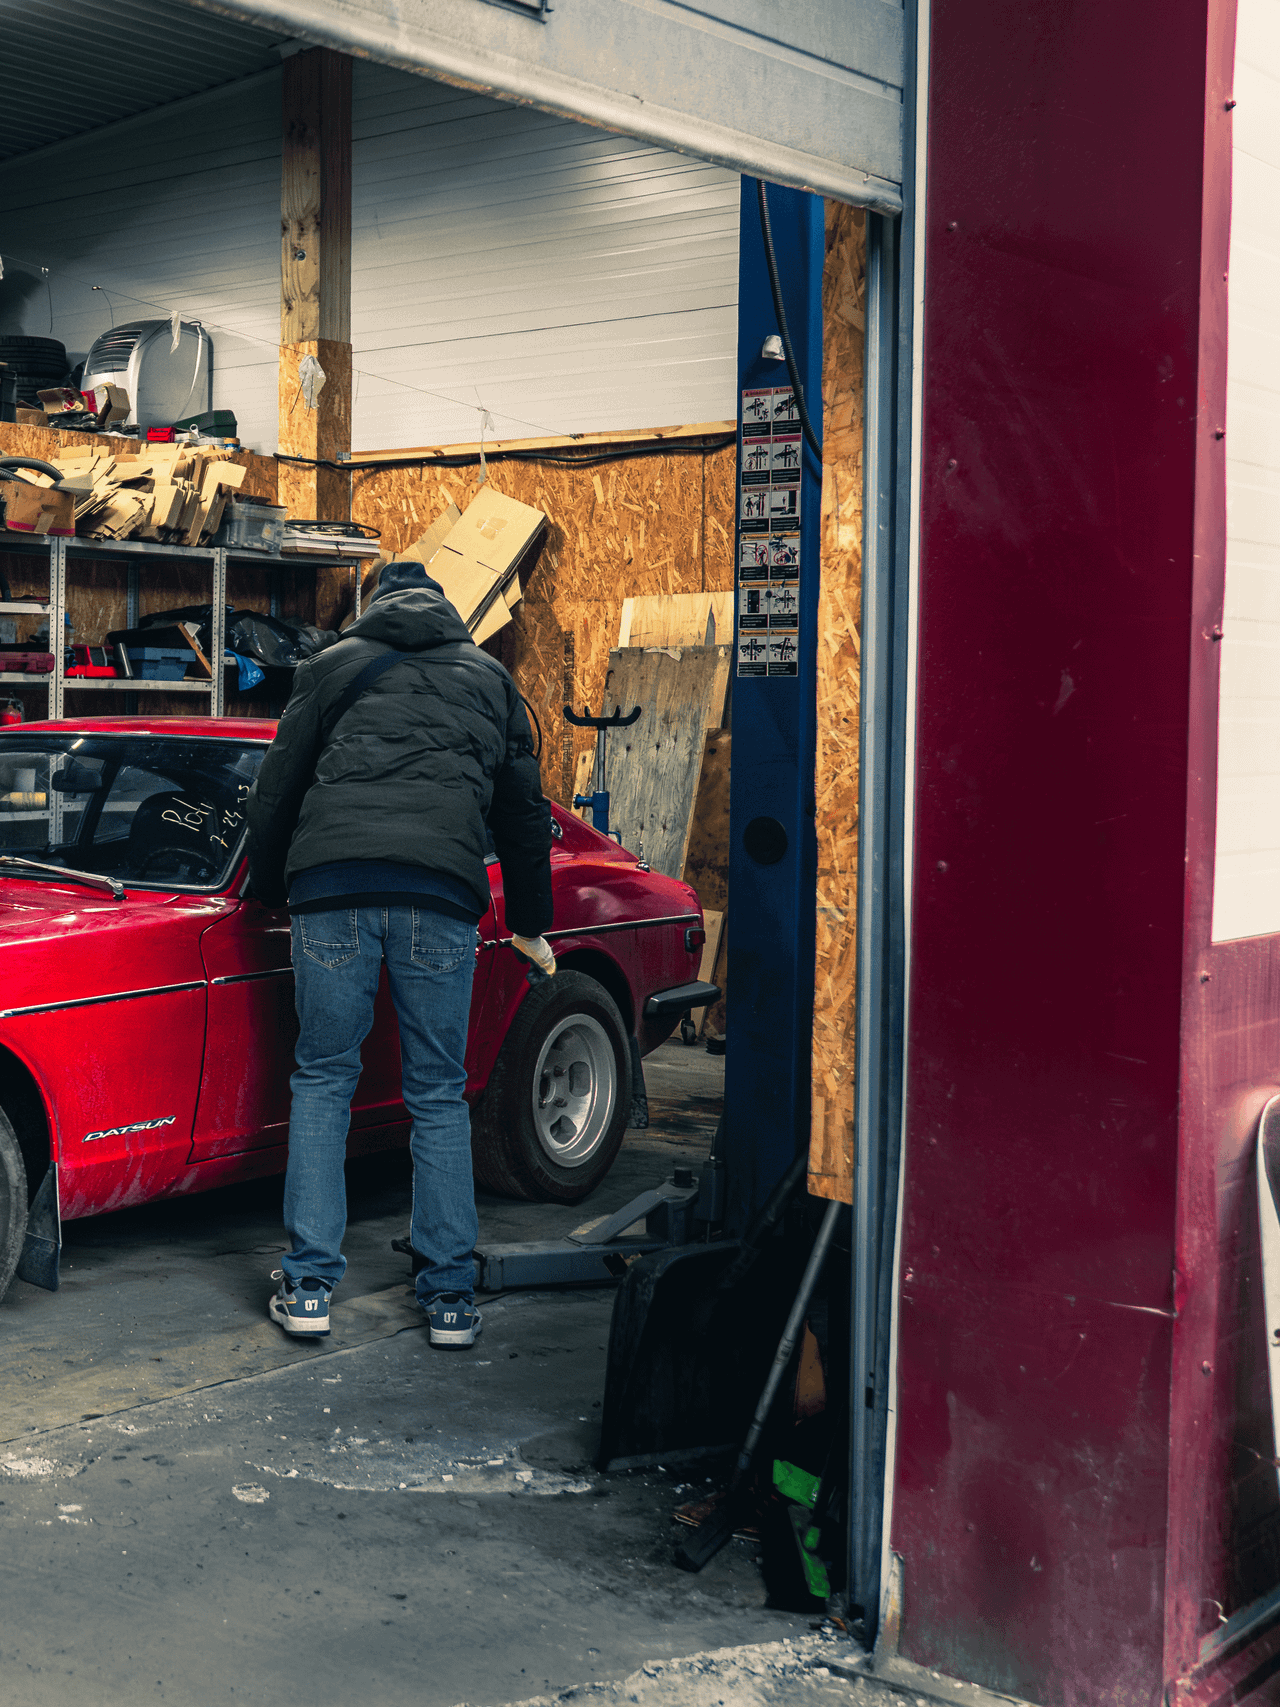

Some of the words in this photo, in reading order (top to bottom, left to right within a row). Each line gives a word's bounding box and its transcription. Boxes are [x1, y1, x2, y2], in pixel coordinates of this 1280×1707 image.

[82, 1115, 176, 1143] DATSUN
[304, 1299, 318, 1311] 07
[443, 1312, 458, 1324] 07
